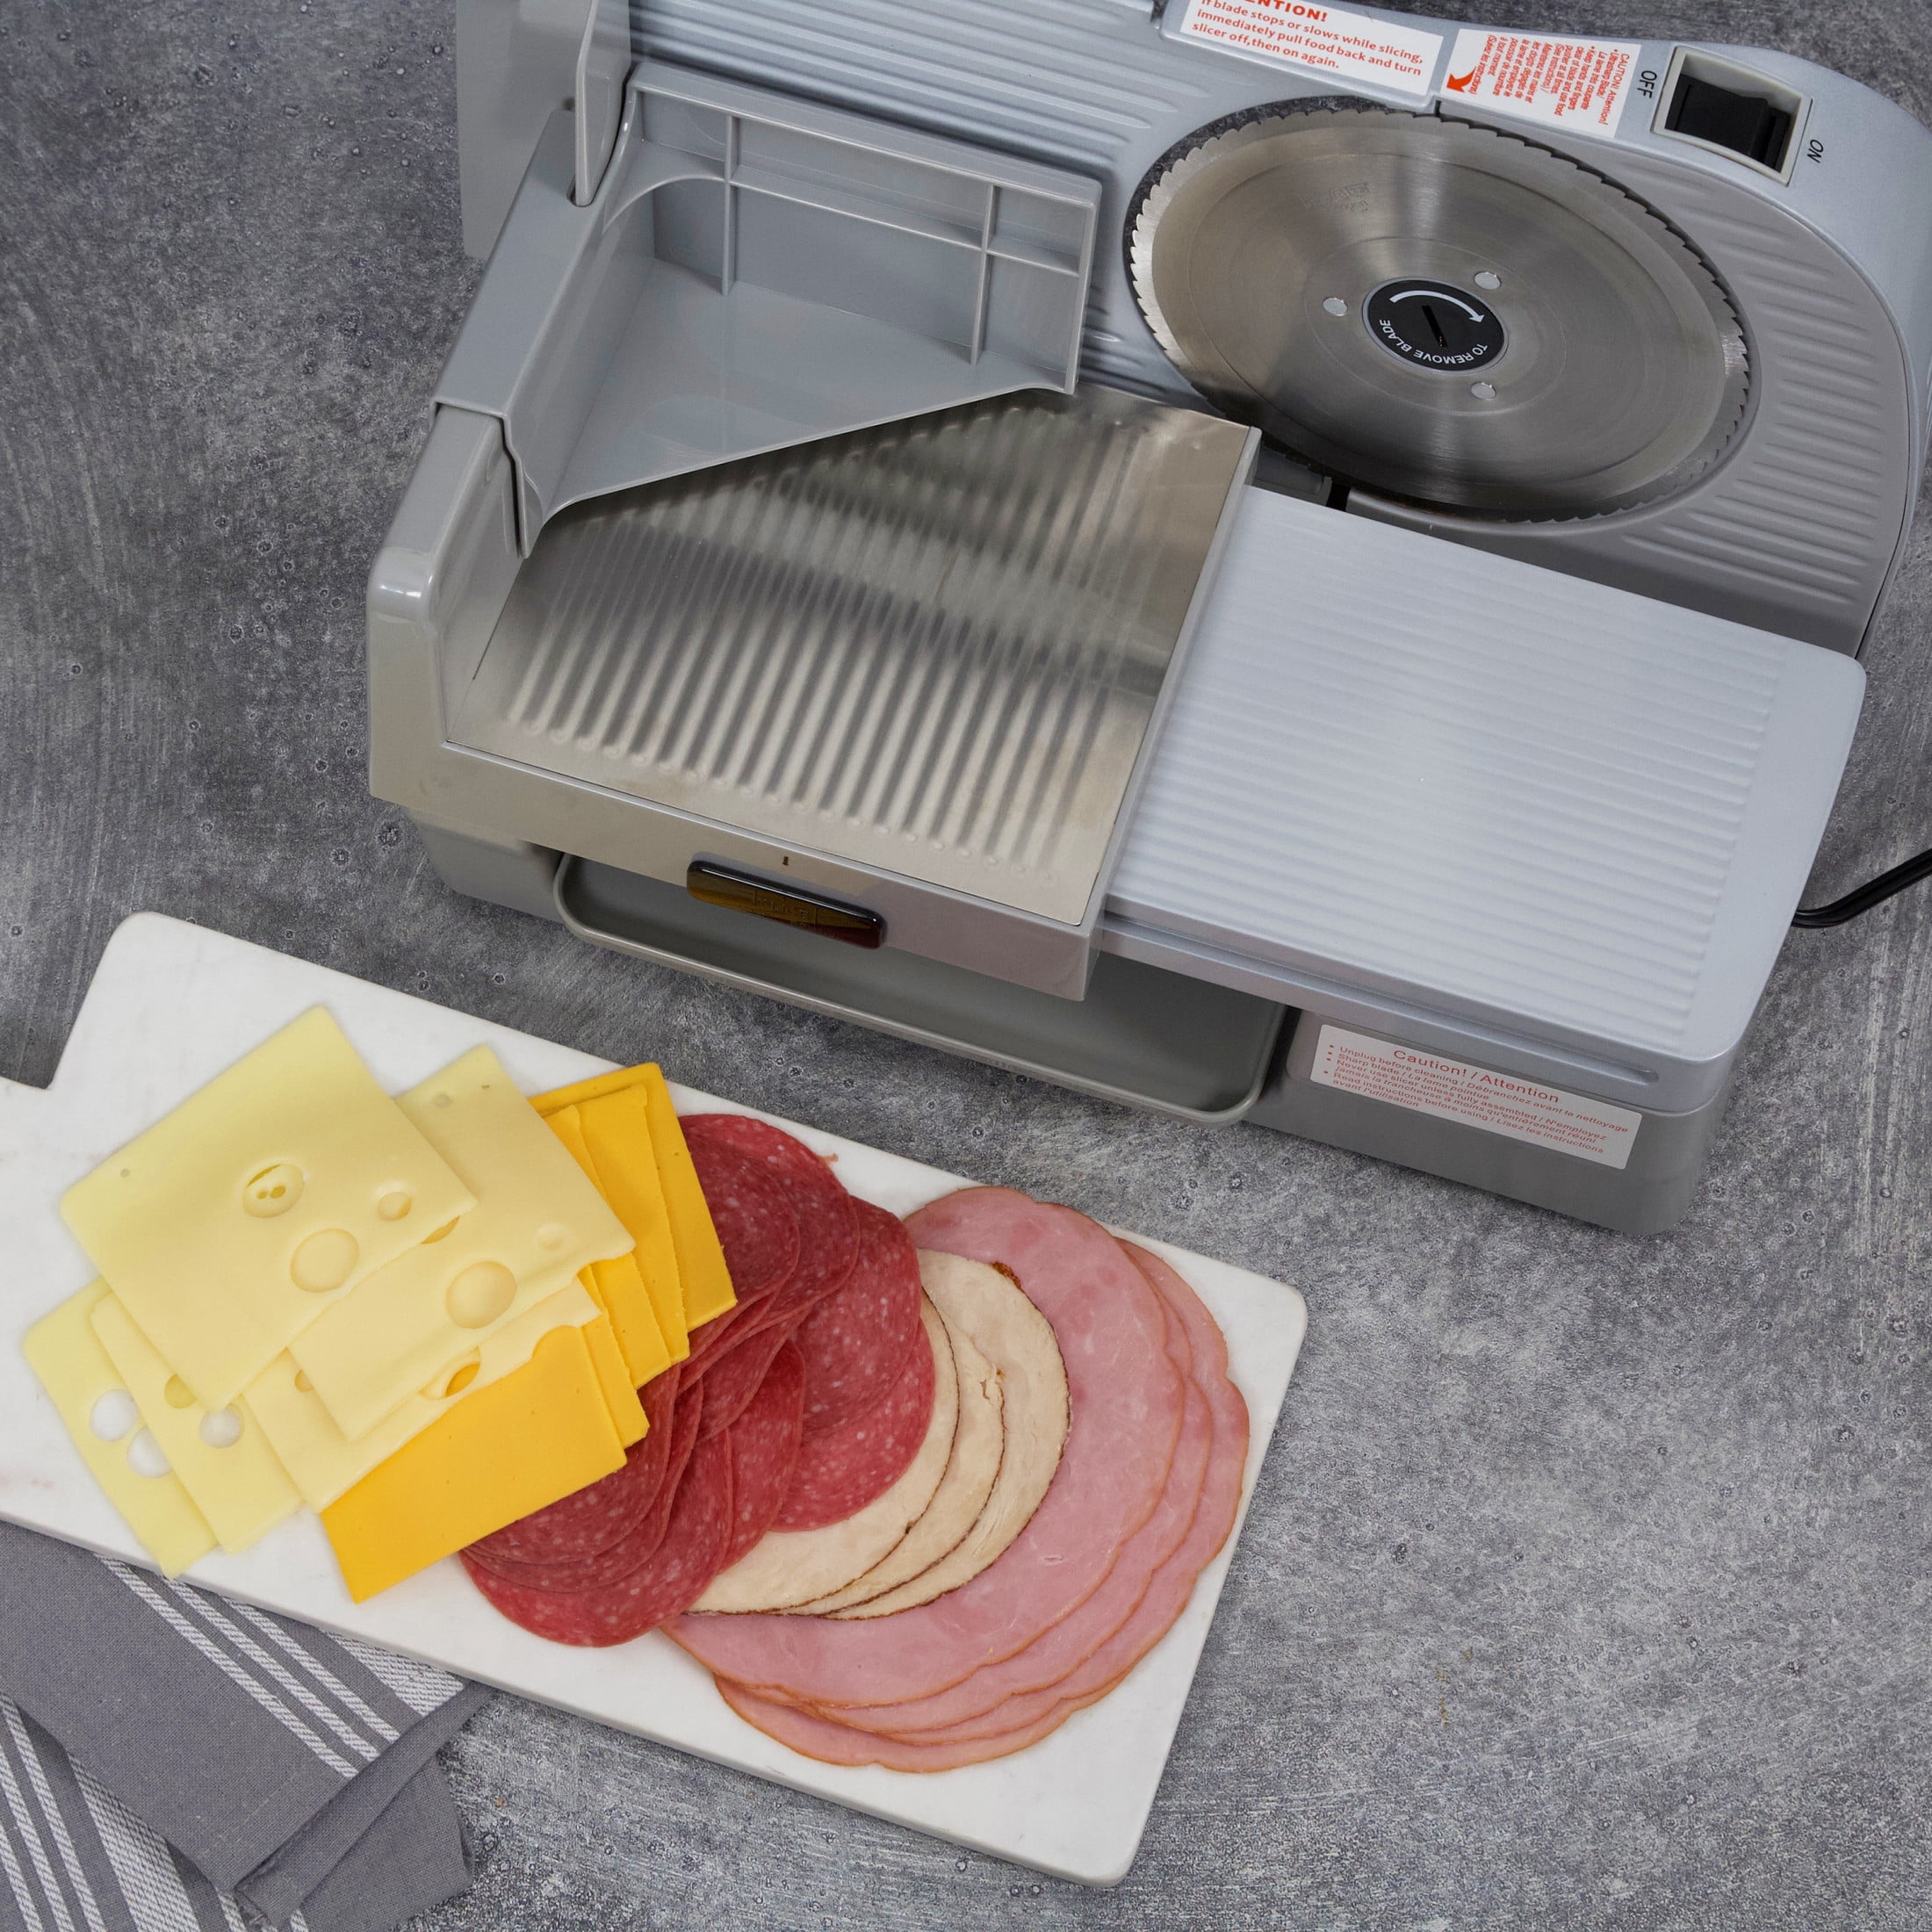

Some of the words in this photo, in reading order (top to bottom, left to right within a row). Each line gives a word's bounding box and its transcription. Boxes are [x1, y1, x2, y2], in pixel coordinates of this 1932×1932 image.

[1246, 0, 1328, 21] NTION!
[1197, 10, 1276, 39] immediately
[1276, 32, 1304, 44] pull
[1304, 38, 1337, 54] food
[1336, 47, 1366, 61] back
[1367, 56, 1394, 68] and
[1394, 62, 1423, 76] turn
[1213, 0, 1250, 16] blade
[1251, 11, 1286, 26] stops
[1286, 21, 1302, 30] or
[1302, 25, 1340, 40] slows
[1341, 36, 1377, 50] while
[1378, 45, 1424, 64] slicing,
[1193, 23, 1228, 37] slicer
[1281, 47, 1300, 57] on
[1301, 53, 1338, 68] again.
[1483, 34, 1497, 54] (Suivez
[1496, 41, 1506, 53] tout
[1504, 38, 1518, 61] poussoir
[1517, 45, 1527, 59] lame
[1554, 44, 1566, 56] (See
[1561, 45, 1573, 64] pusher
[1574, 47, 1583, 59] clear
[1583, 48, 1596, 63] Keep
[1481, 53, 1489, 62] les
[1525, 50, 1538, 68] doigts
[1536, 43, 1552, 70] Maintenez
[1593, 58, 1604, 73] lame
[1602, 52, 1618, 80] Ultrasharp
[1469, 61, 1486, 94] instructions)
[1493, 70, 1507, 96] nourriture
[1505, 65, 1519, 90] employez
[1533, 70, 1542, 79] les
[1542, 55, 1560, 89] instructions)
[1566, 66, 1577, 81] blade
[1578, 64, 1590, 80] hands
[1611, 54, 1630, 89] CAUTION!
[1527, 80, 1538, 96] mains
[1562, 81, 1571, 92] and
[1574, 80, 1583, 92] and
[1637, 70, 1658, 98] OFF
[1554, 102, 1566, 116] food
[1559, 92, 1568, 103] use
[1568, 91, 1581, 110] fingers
[1581, 85, 1593, 110] coupante
[1599, 90, 1616, 125] Attention!
[1806, 139, 1824, 163] ON
[1379, 319, 1412, 353] BLADE
[1414, 350, 1474, 364] REMOVE
[1472, 343, 1489, 356] TO
[1337, 1053, 1368, 1066] Sharp
[1371, 1062, 1399, 1076] blade
[1407, 1072, 1422, 1081] La
[1423, 1078, 1448, 1088] lame
[1450, 1085, 1489, 1100] pointue
[1393, 1049, 1467, 1076] Caution!
[1480, 1074, 1559, 1102] Attention
[1332, 1079, 1360, 1090] avant
[1363, 1087, 1419, 1107] l'utilisation
[1336, 1065, 1371, 1080] jamais
[1382, 1079, 1442, 1099] trancheuse
[1453, 1099, 1485, 1113] moins
[1337, 1059, 1366, 1071] Never
[1390, 1075, 1419, 1085] slicer
[1422, 1085, 1454, 1097] unless
[1457, 1092, 1479, 1105] fully
[1481, 1100, 1537, 1121] assembled
[1545, 1119, 1606, 1141] N'employez
[1339, 1047, 1377, 1063] Unplug
[1378, 1056, 1412, 1071] before
[1414, 1069, 1459, 1085] cleaning
[1467, 1082, 1531, 1105] Débranchez
[1532, 1101, 1562, 1113] avant
[1577, 1114, 1628, 1132] nettoyage
[1333, 1071, 1361, 1085] Read
[1362, 1081, 1423, 1102] instructions
[1424, 1098, 1459, 1112] before
[1461, 1109, 1489, 1121] using
[1496, 1118, 1524, 1130] Lisez
[1544, 1132, 1603, 1153] instructions
